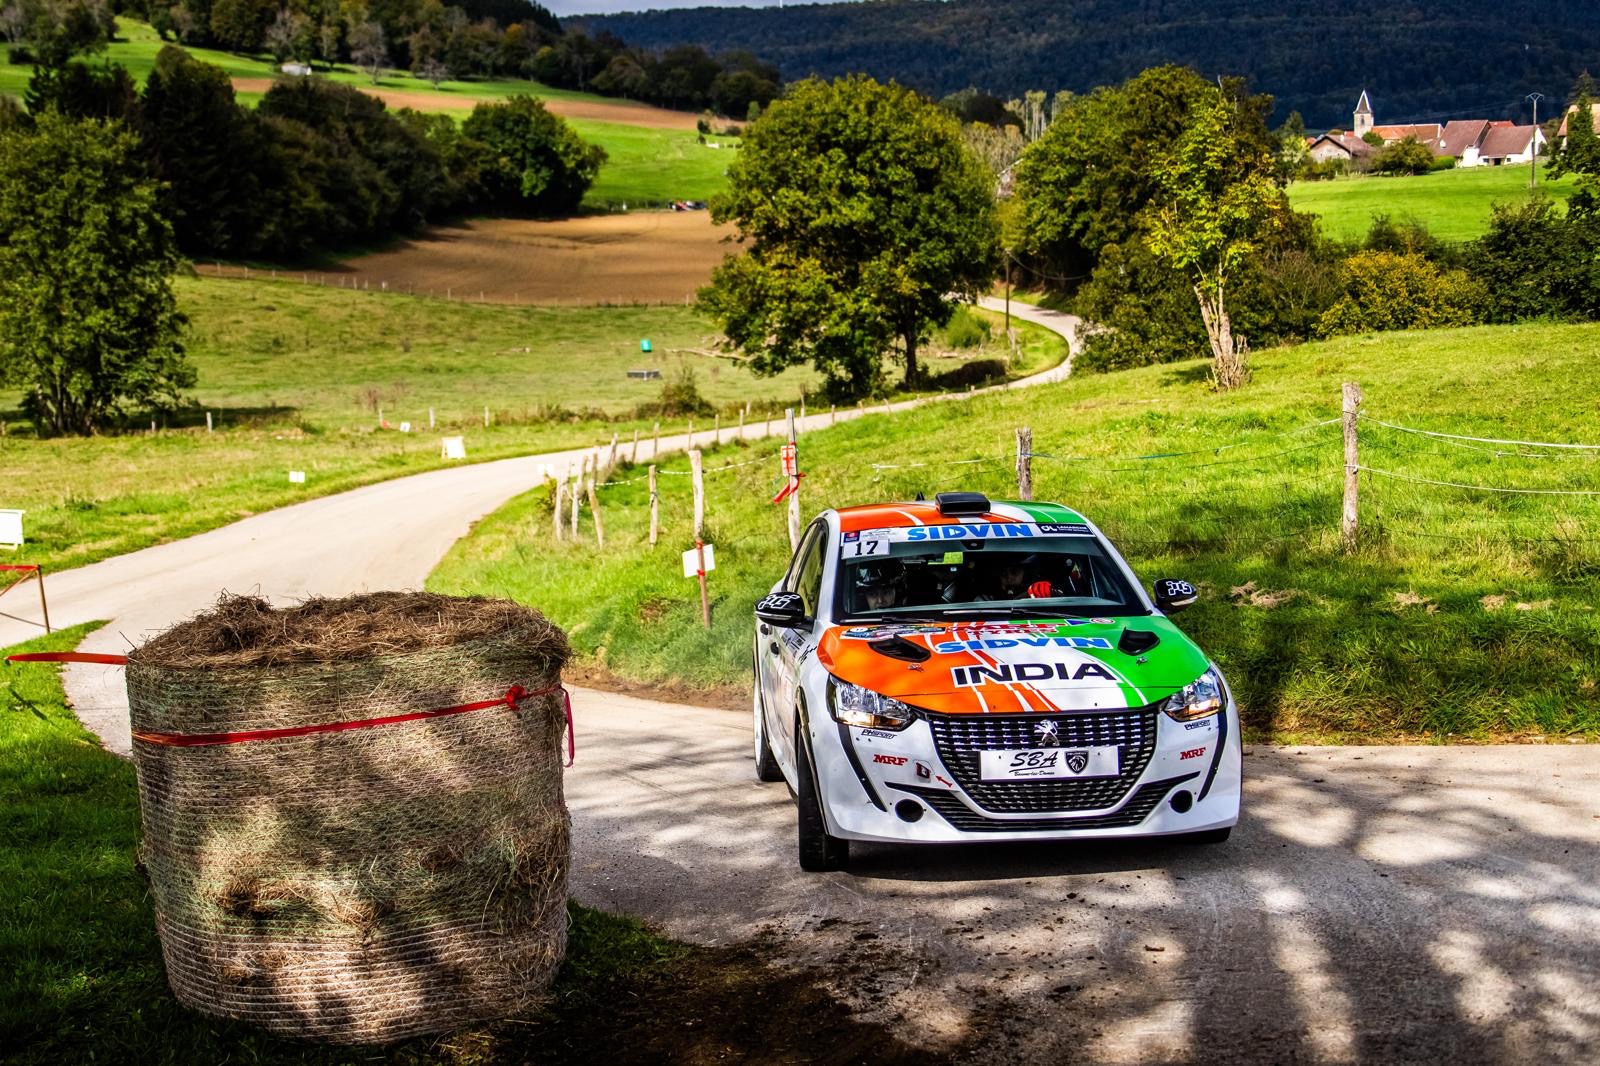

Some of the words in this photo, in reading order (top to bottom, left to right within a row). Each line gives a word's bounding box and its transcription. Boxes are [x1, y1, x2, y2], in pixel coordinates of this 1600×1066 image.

[907, 524, 1034, 541] SIDVIN
[855, 540, 879, 556] 17
[937, 637, 1110, 653] SIDVIN
[953, 662, 1118, 686] INDIA
[873, 753, 908, 766] MRF
[1009, 751, 1059, 767] SBA
[1180, 747, 1206, 760] MRF
